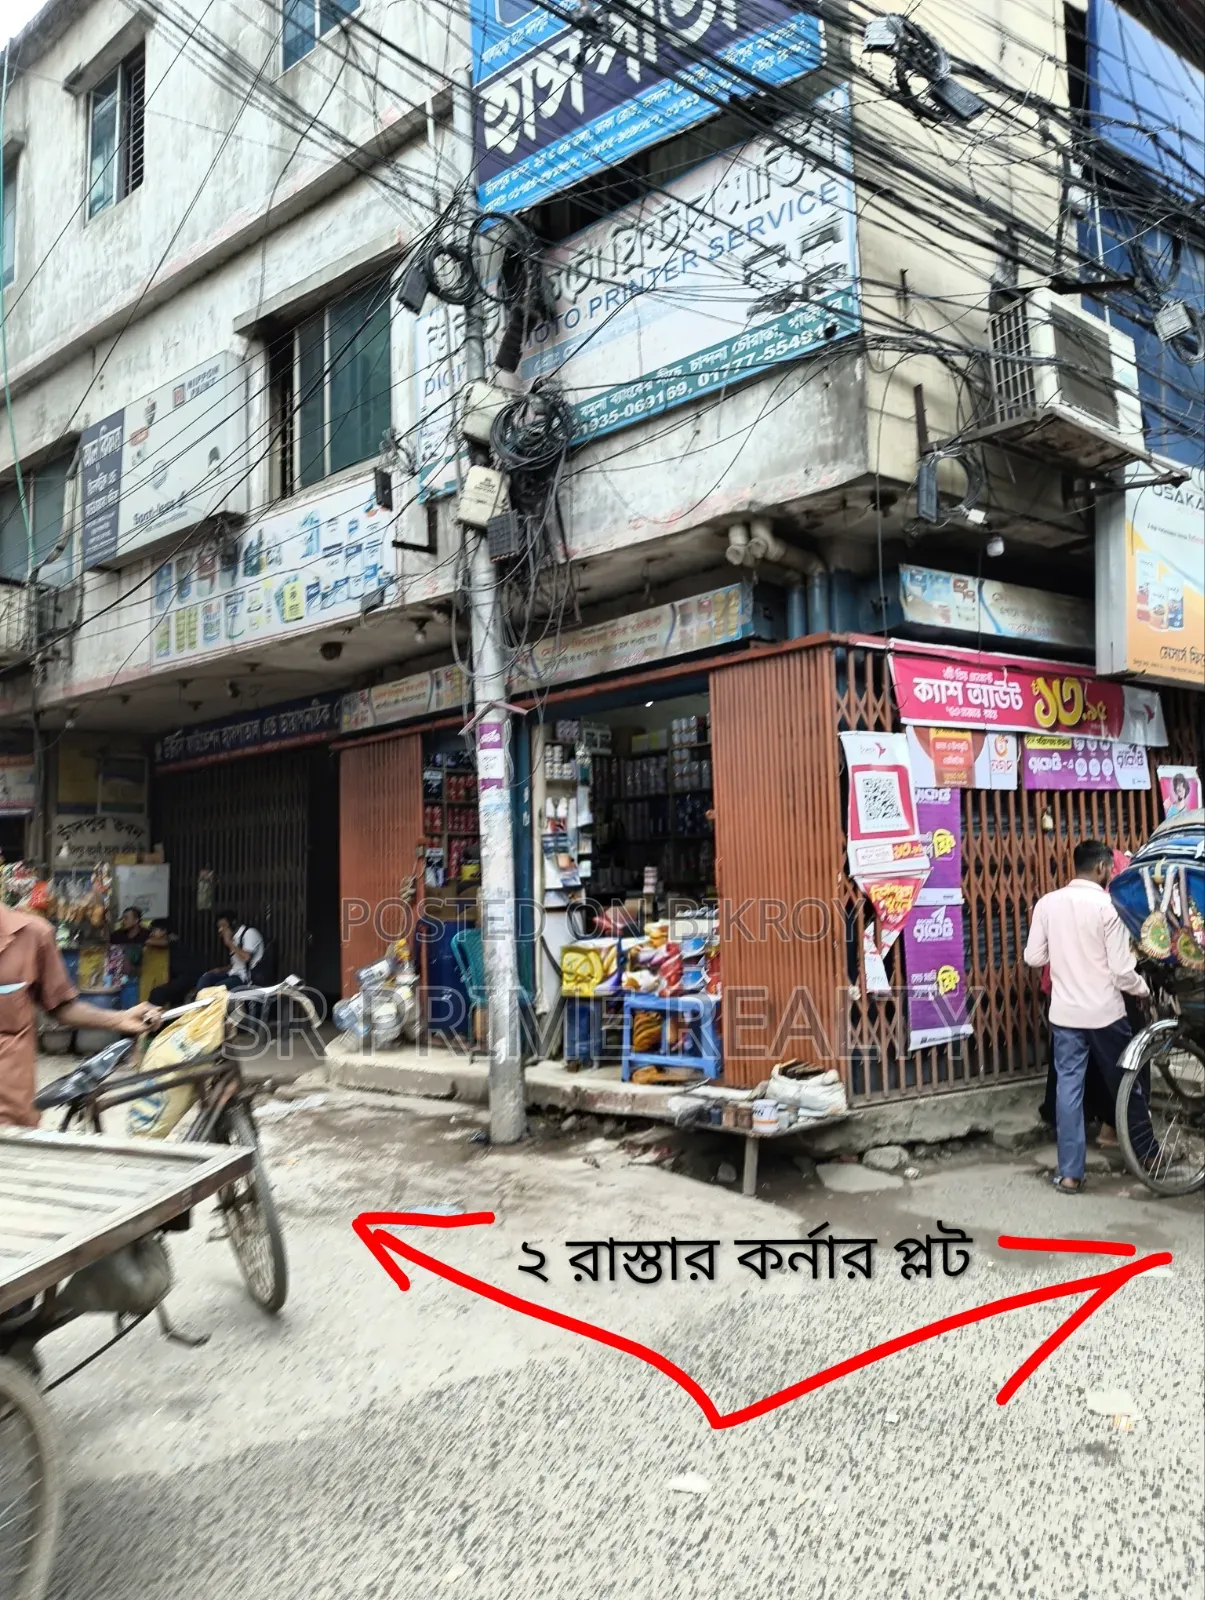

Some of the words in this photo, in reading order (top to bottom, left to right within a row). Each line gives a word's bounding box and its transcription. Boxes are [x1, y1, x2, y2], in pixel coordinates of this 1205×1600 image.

[589, 249, 699, 315] PRINTER
[708, 178, 839, 261] SERVICE
[570, 381, 693, 438] 1935-069169,
[913, 677, 964, 706] ক্যাশ
[966, 666, 1023, 710] আউট
